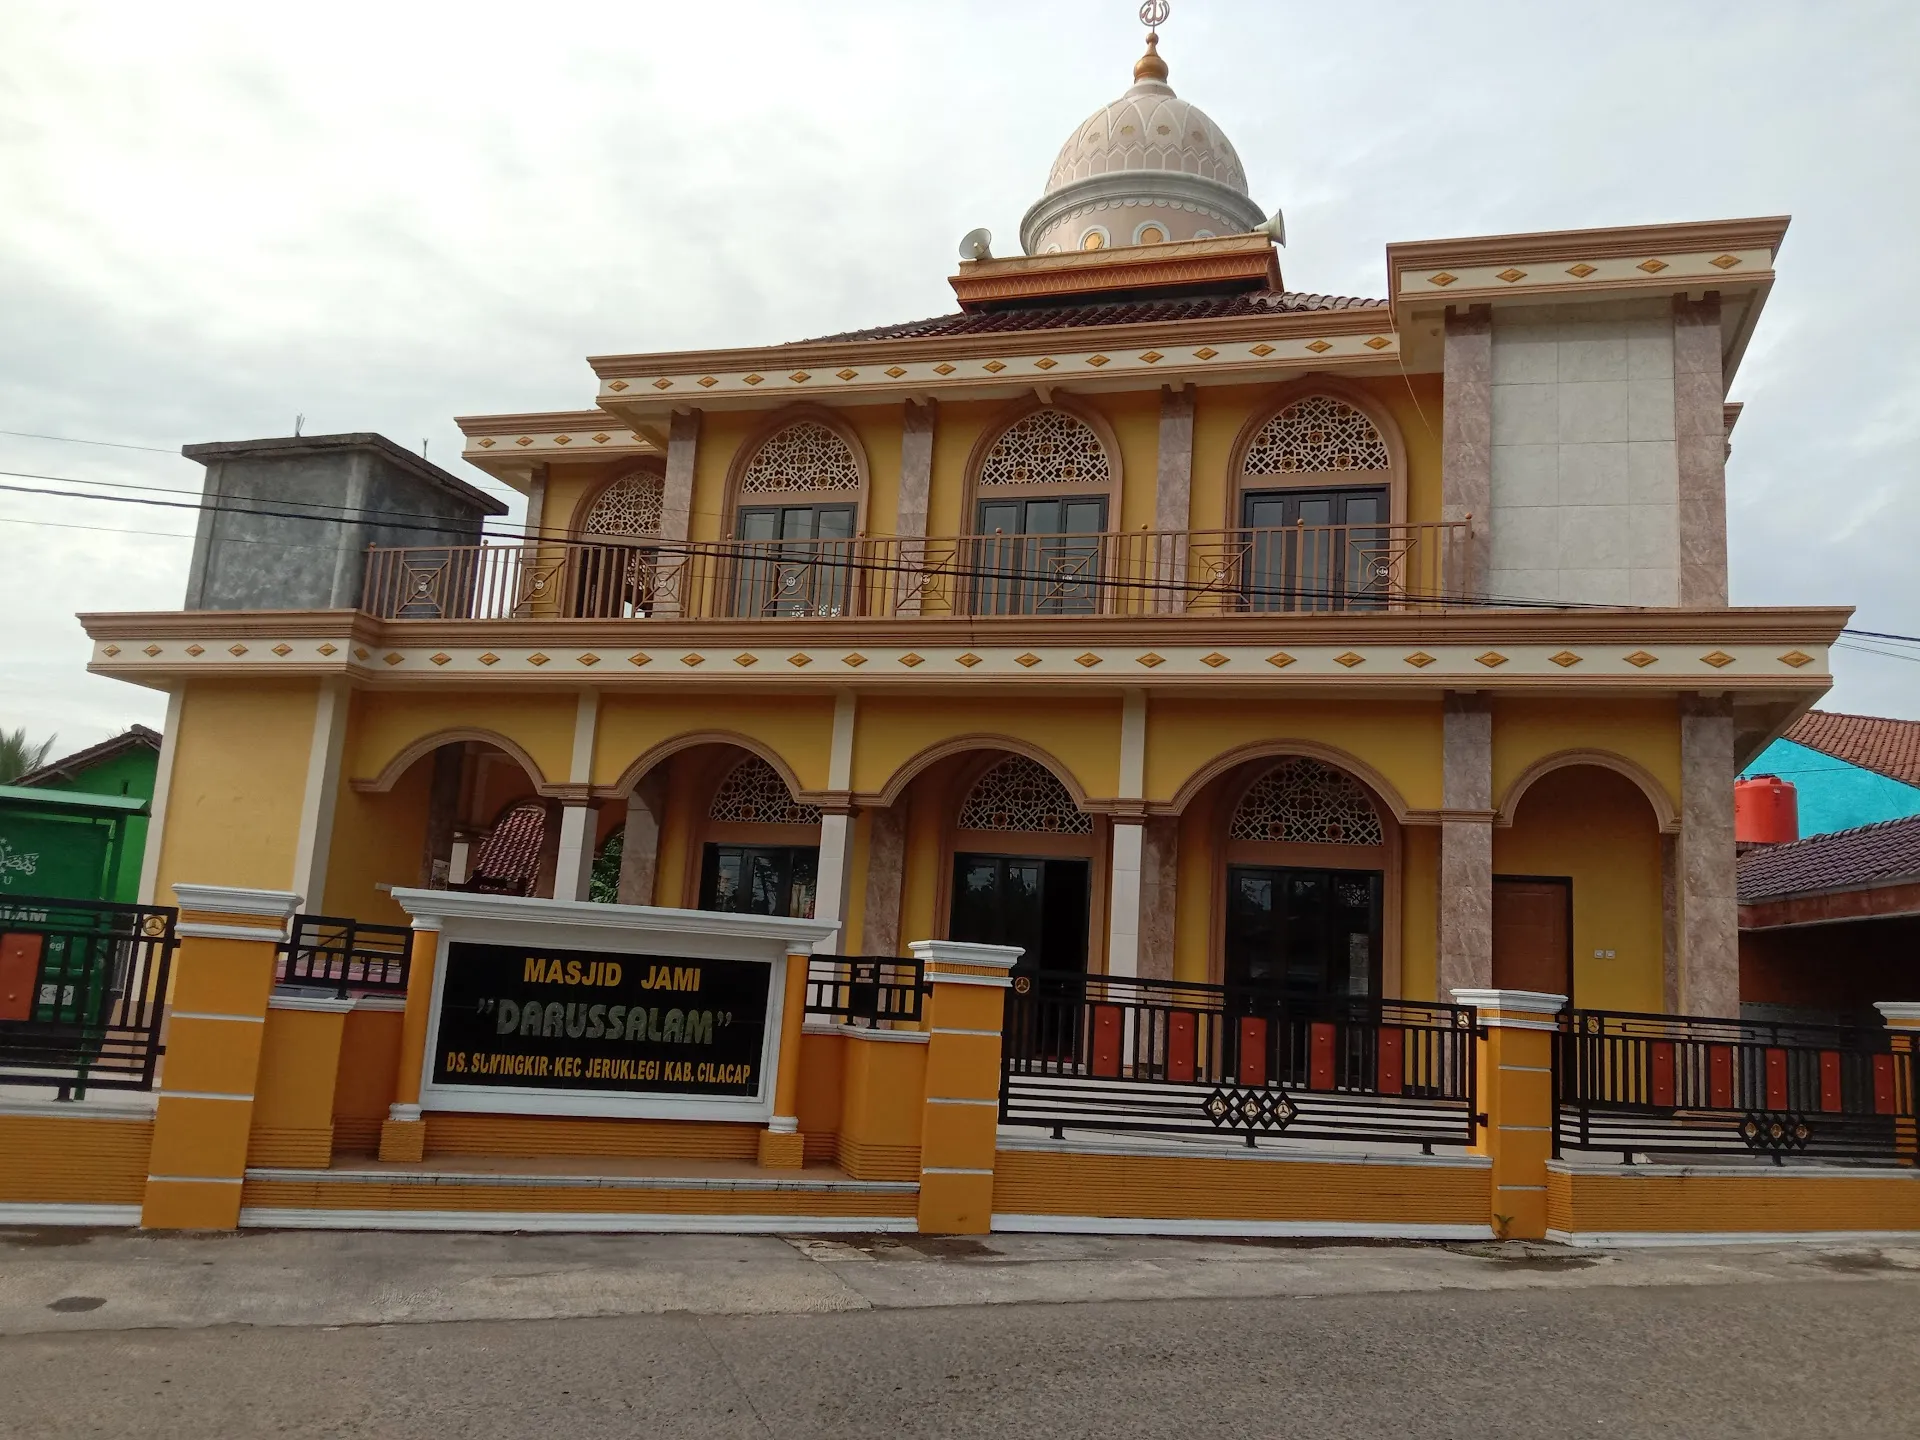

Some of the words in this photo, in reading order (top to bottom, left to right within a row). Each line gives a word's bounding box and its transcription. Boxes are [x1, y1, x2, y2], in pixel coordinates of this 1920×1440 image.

[523, 957, 622, 987] MASJID
[640, 965, 701, 992] JAMI
[585, 1058, 660, 1081] JERUKLEGI
[663, 1061, 695, 1082] KAB.
[697, 1062, 751, 1084] CILACAP
